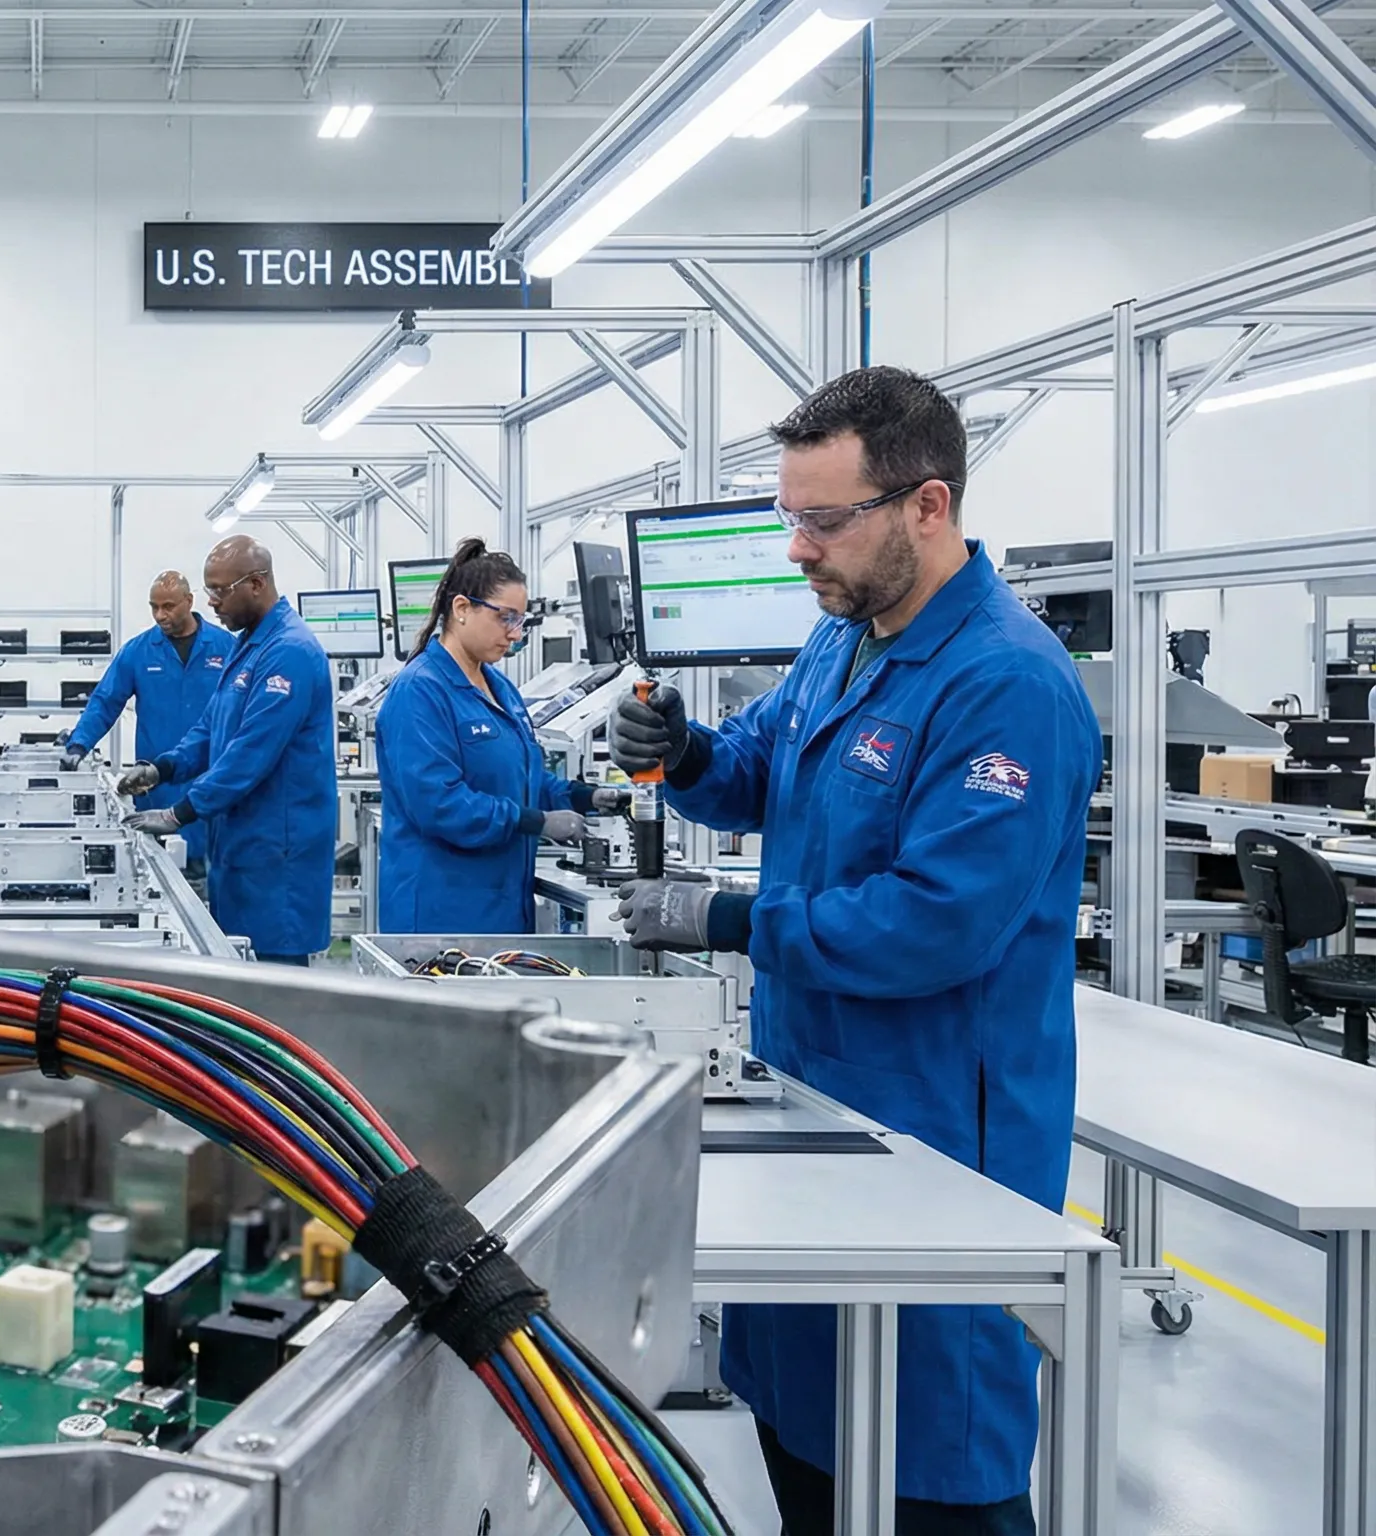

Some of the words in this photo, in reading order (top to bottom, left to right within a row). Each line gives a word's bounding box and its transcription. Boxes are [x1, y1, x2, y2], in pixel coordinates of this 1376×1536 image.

[155, 248, 226, 286] U.S.
[237, 248, 333, 286] TECH
[343, 248, 532, 286] ASSEMBL
